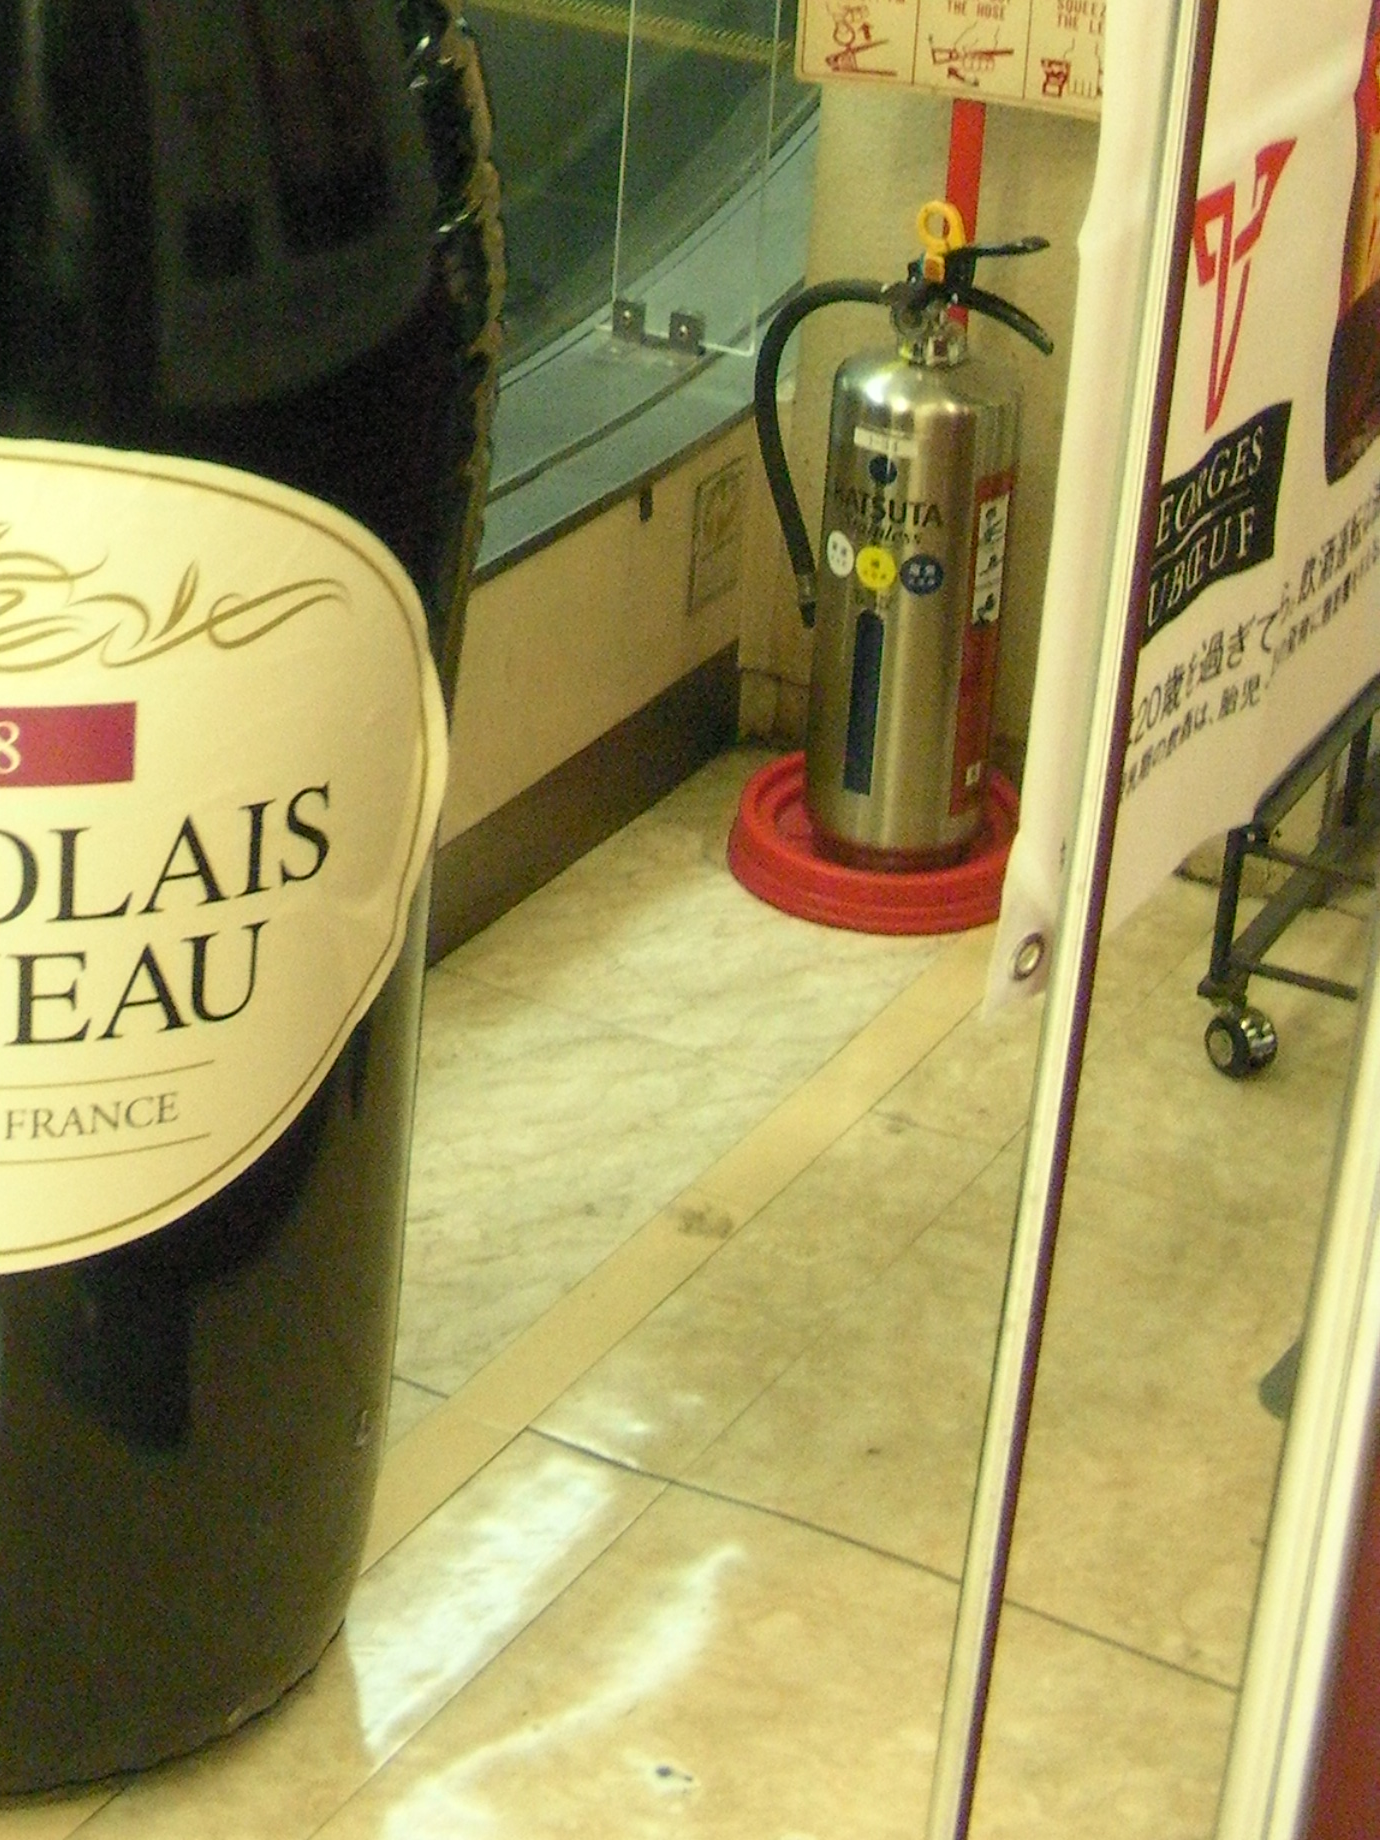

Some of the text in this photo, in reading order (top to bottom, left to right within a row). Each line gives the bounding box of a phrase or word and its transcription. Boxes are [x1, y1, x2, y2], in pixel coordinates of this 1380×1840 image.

[947, 0, 1006, 22] THE HOSE
[1057, 12, 1080, 31] THE
[4, 1091, 180, 1140] FRANCE
